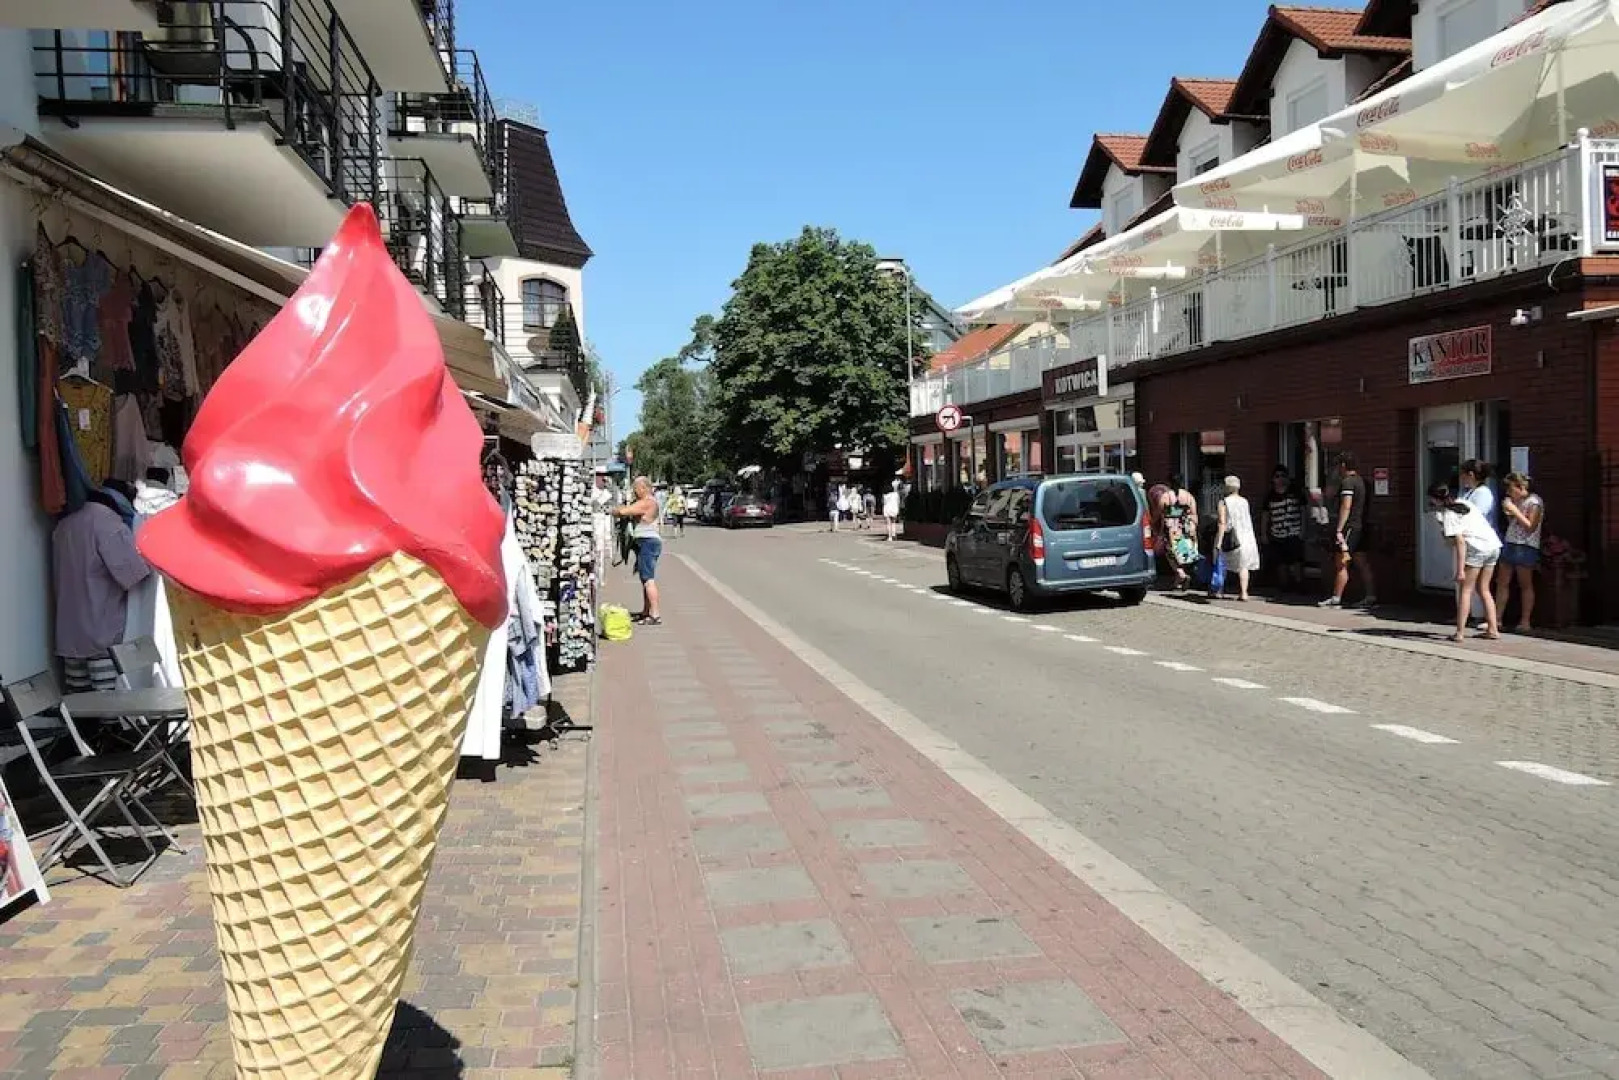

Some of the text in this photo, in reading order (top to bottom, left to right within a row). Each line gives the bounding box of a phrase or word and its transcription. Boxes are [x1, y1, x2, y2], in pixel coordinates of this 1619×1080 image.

[1356, 96, 1400, 128] Coca-Cola
[1287, 149, 1322, 173] Coca-Cola
[1209, 213, 1244, 228] Coca-Cola
[1413, 330, 1488, 366] KANTOR
